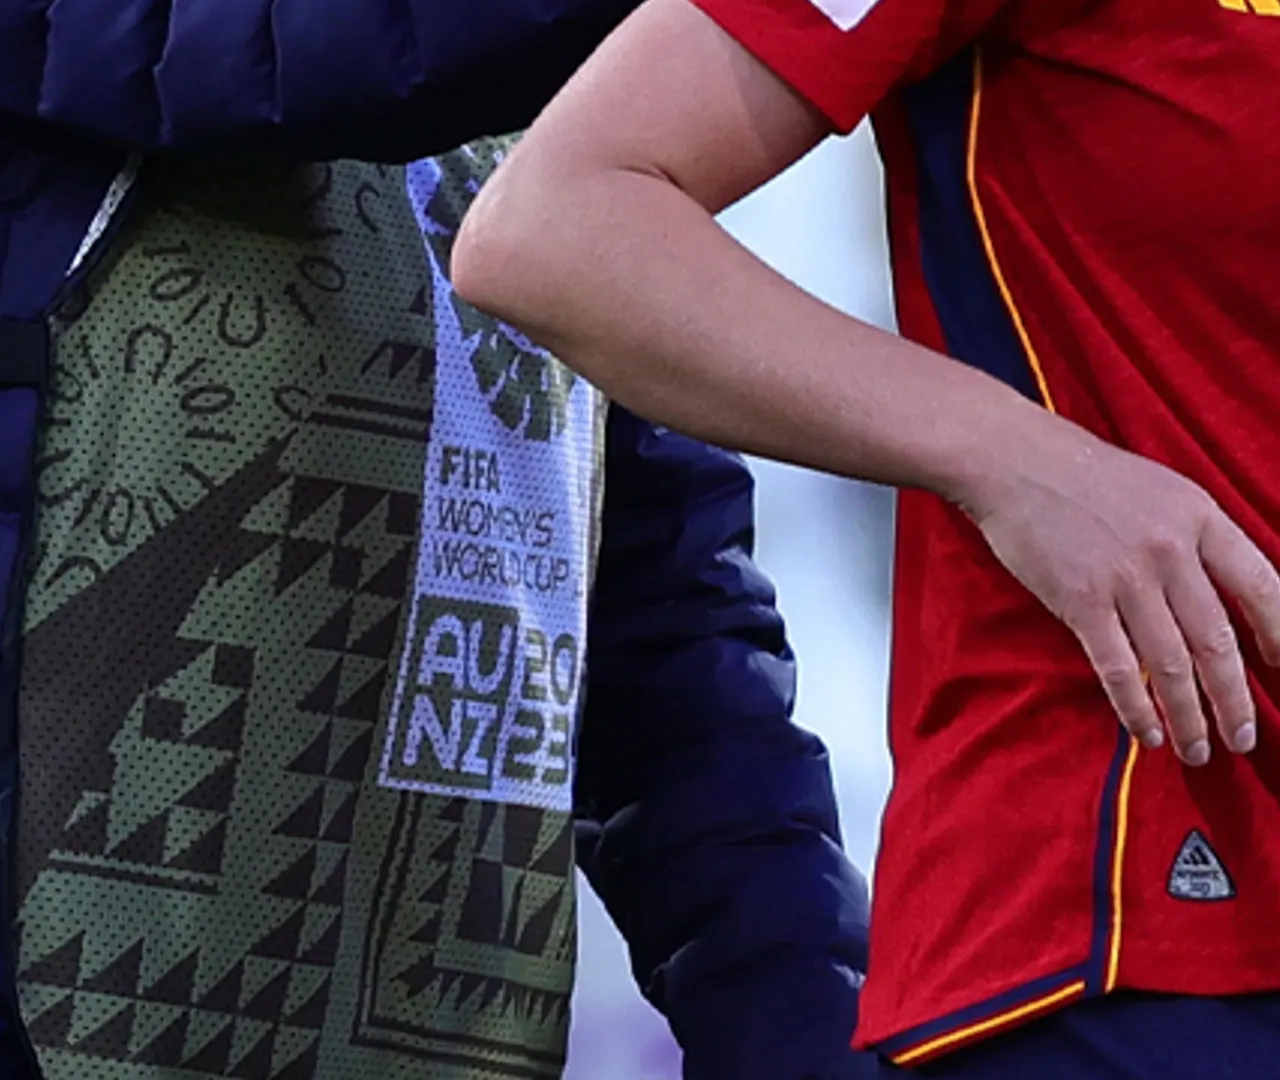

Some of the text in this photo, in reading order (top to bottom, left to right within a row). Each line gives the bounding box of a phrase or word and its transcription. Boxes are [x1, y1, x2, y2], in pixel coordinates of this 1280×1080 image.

[439, 445, 501, 494] FIFA
[523, 552, 570, 599] CUP
[416, 613, 578, 707] AU 20
[402, 692, 571, 785] NZ 23
